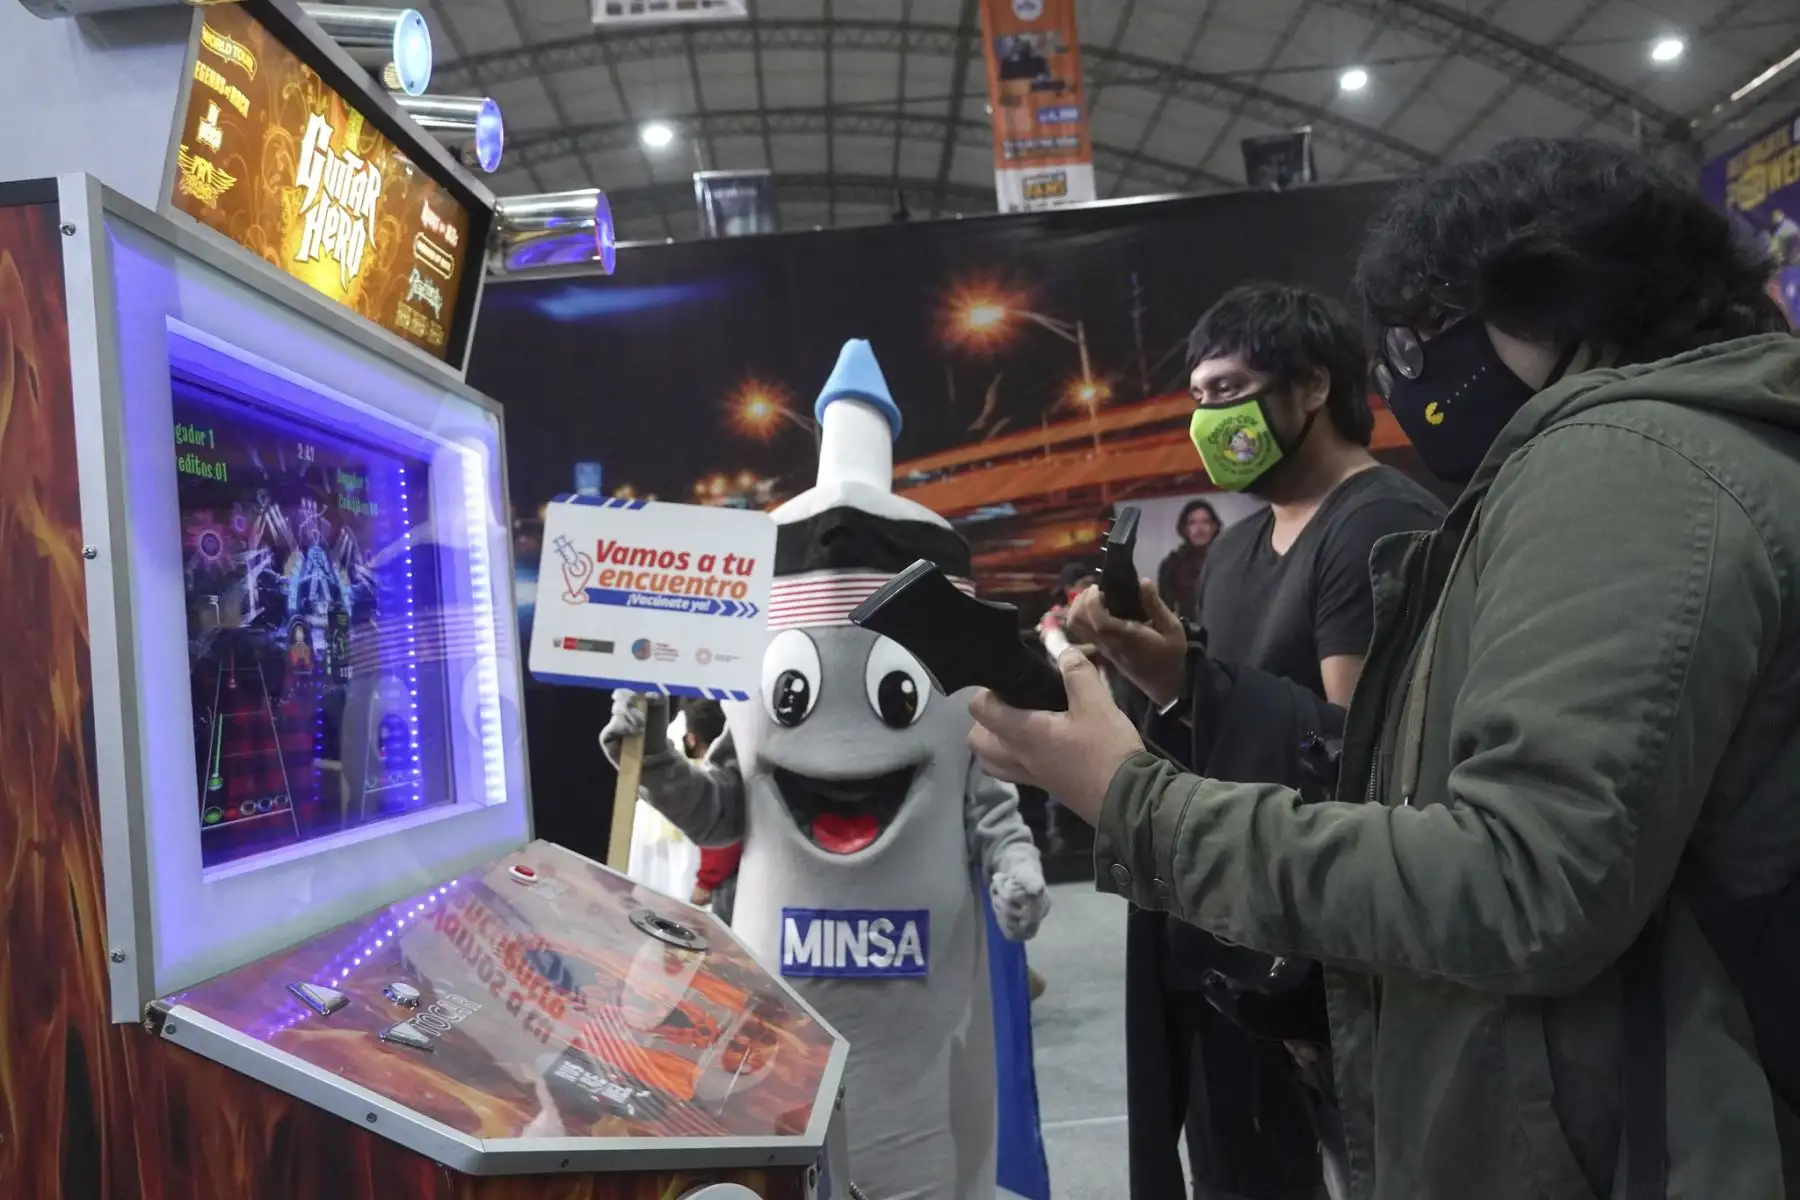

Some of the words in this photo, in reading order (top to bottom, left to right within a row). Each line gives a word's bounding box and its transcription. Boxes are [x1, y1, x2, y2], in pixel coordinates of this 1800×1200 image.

[194, 60, 226, 95] EGENDS
[175, 422, 206, 447] gador
[596, 539, 690, 571] Vamos
[698, 554, 716, 573] a
[723, 553, 755, 576] tu
[599, 568, 748, 599] encuentro
[783, 918, 925, 968] MINSA
[408, 993, 483, 1037] TOCAR
